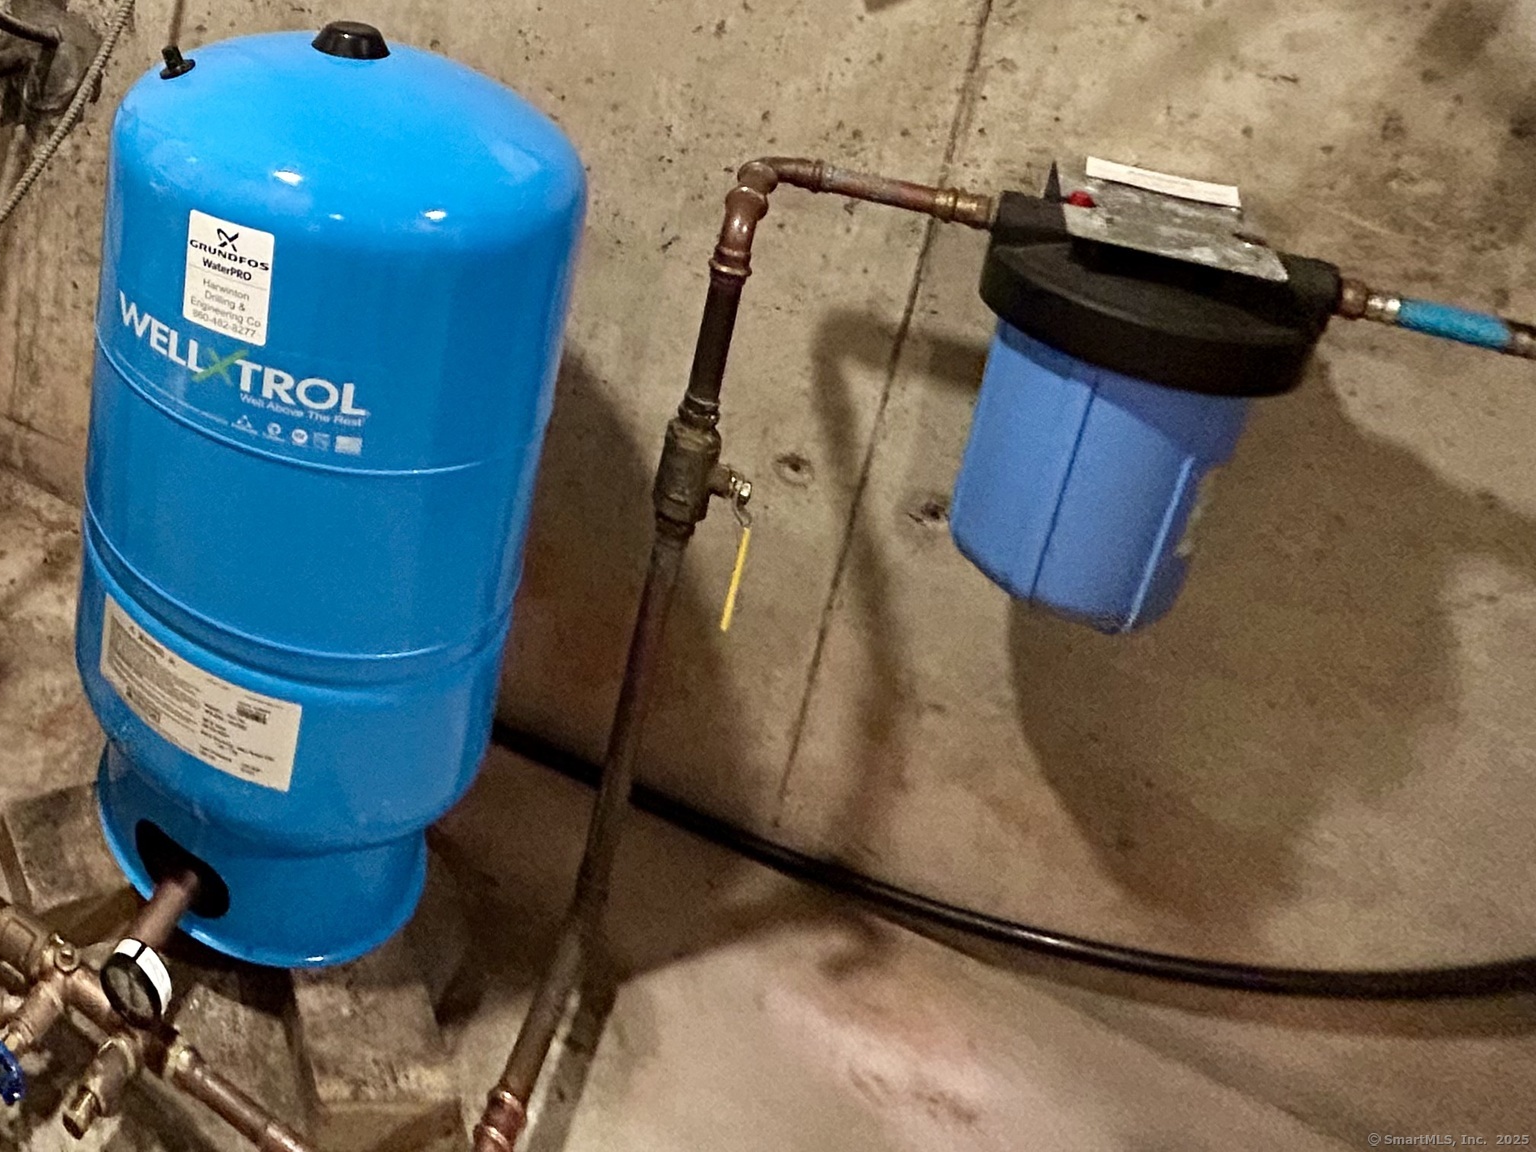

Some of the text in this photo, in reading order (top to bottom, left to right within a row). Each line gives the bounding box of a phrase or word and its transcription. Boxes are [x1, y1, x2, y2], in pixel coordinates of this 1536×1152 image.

[189, 239, 270, 272] GRUNDFOS
[202, 257, 252, 281] WaterPRO
[202, 278, 251, 302] Harwinton
[205, 290, 246, 312] Drilling &
[190, 295, 262, 328] Engineering Co
[239, 392, 363, 428] Well Above The Rest
